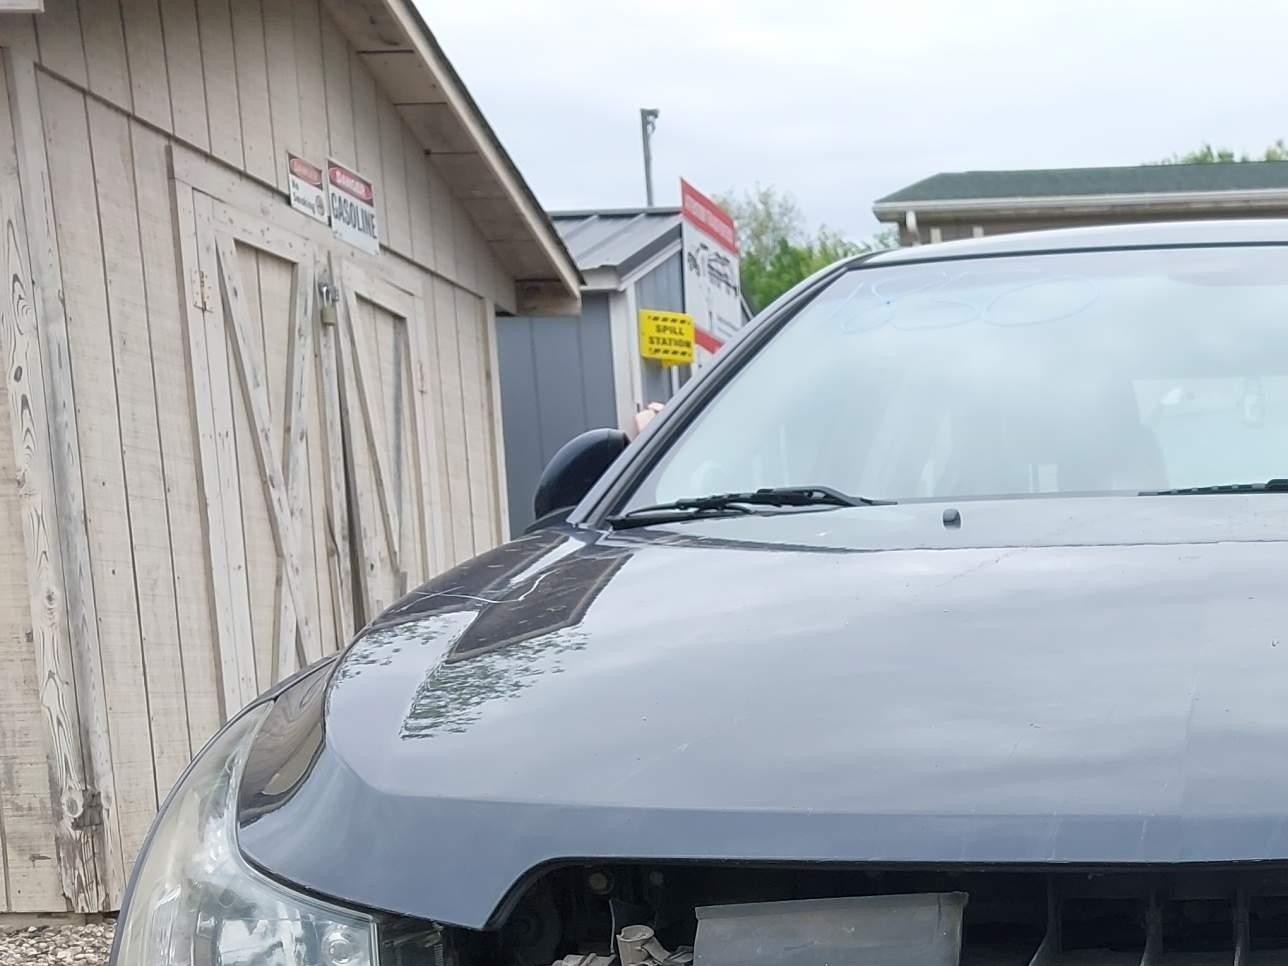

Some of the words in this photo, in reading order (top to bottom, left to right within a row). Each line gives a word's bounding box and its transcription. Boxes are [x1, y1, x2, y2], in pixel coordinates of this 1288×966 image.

[331, 192, 377, 239] GASOLINE
[655, 324, 685, 337] SPILL
[648, 335, 692, 348] STATION
